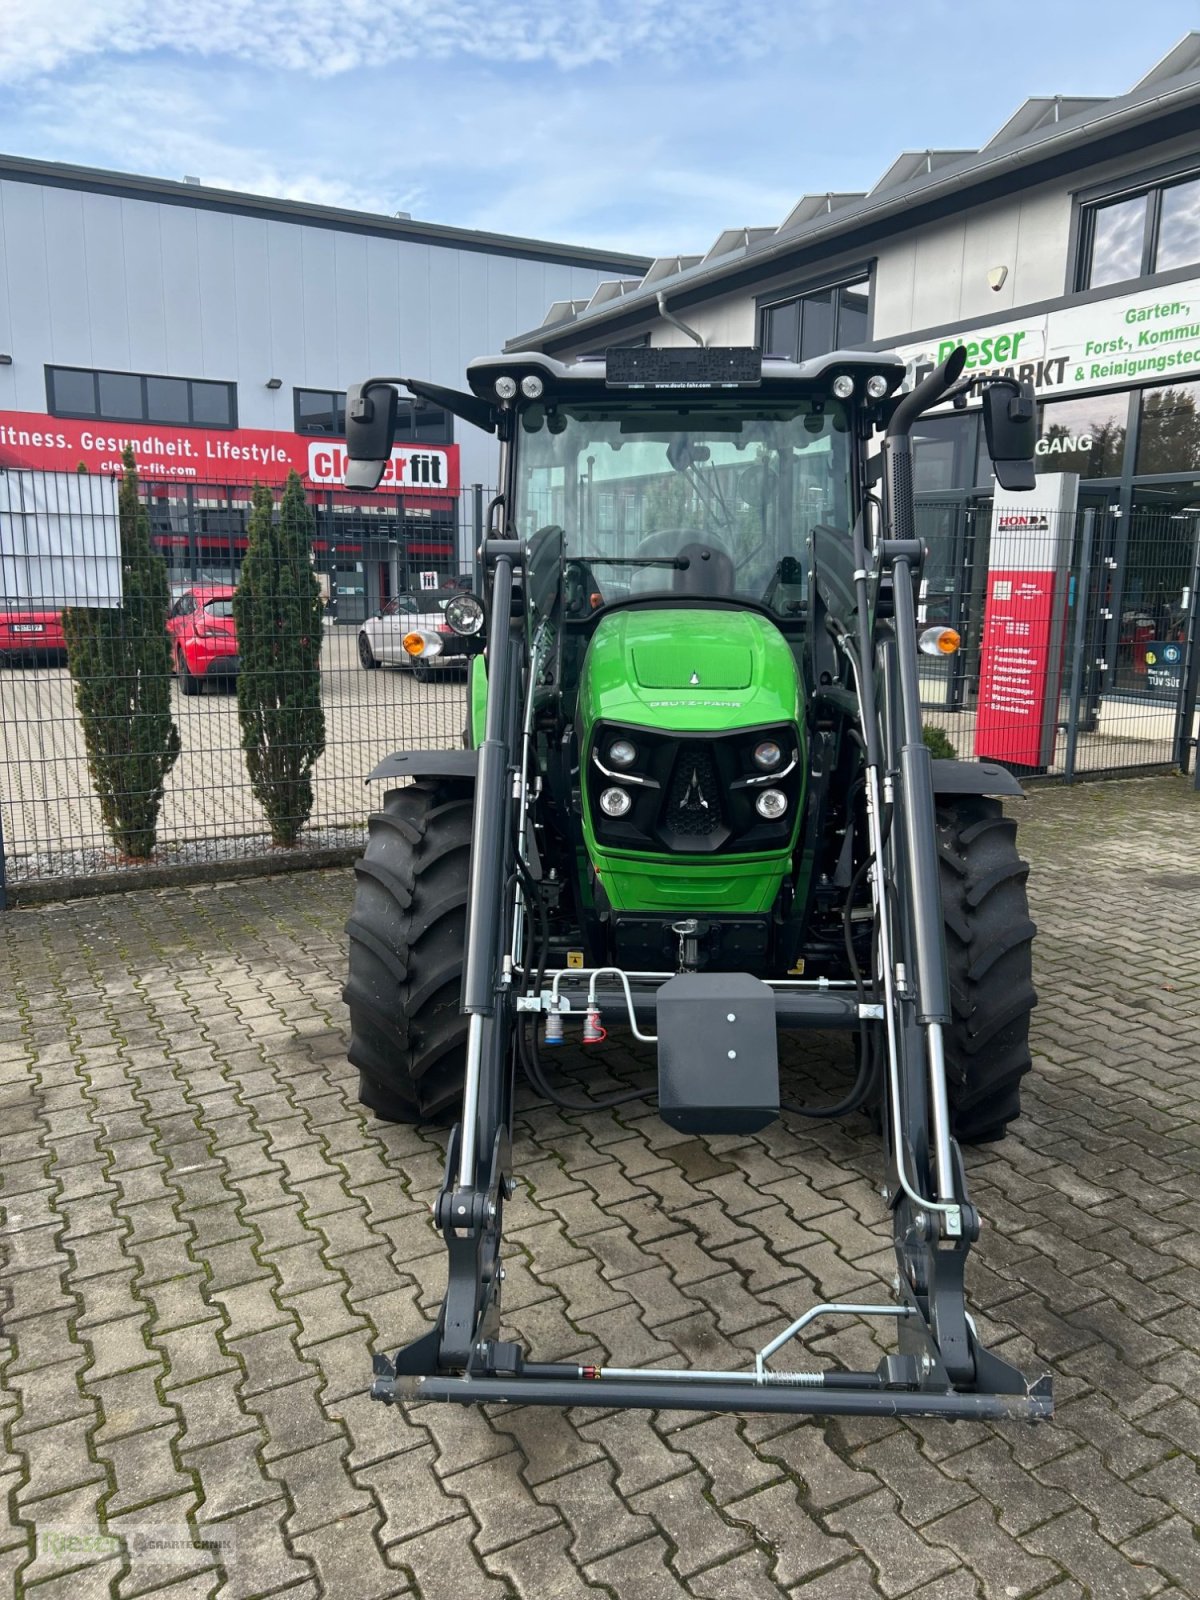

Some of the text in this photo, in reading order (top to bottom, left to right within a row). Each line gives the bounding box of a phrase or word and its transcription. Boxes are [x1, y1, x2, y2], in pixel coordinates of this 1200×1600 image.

[1125, 302, 1191, 324] Garten-,
[1085, 324, 1200, 356] Forst-, Kommu
[1074, 366, 1085, 381] &
[80, 432, 199, 458] Gesundheit.
[206, 441, 293, 464] Lifestyle.
[999, 515, 1048, 526] HONDA
